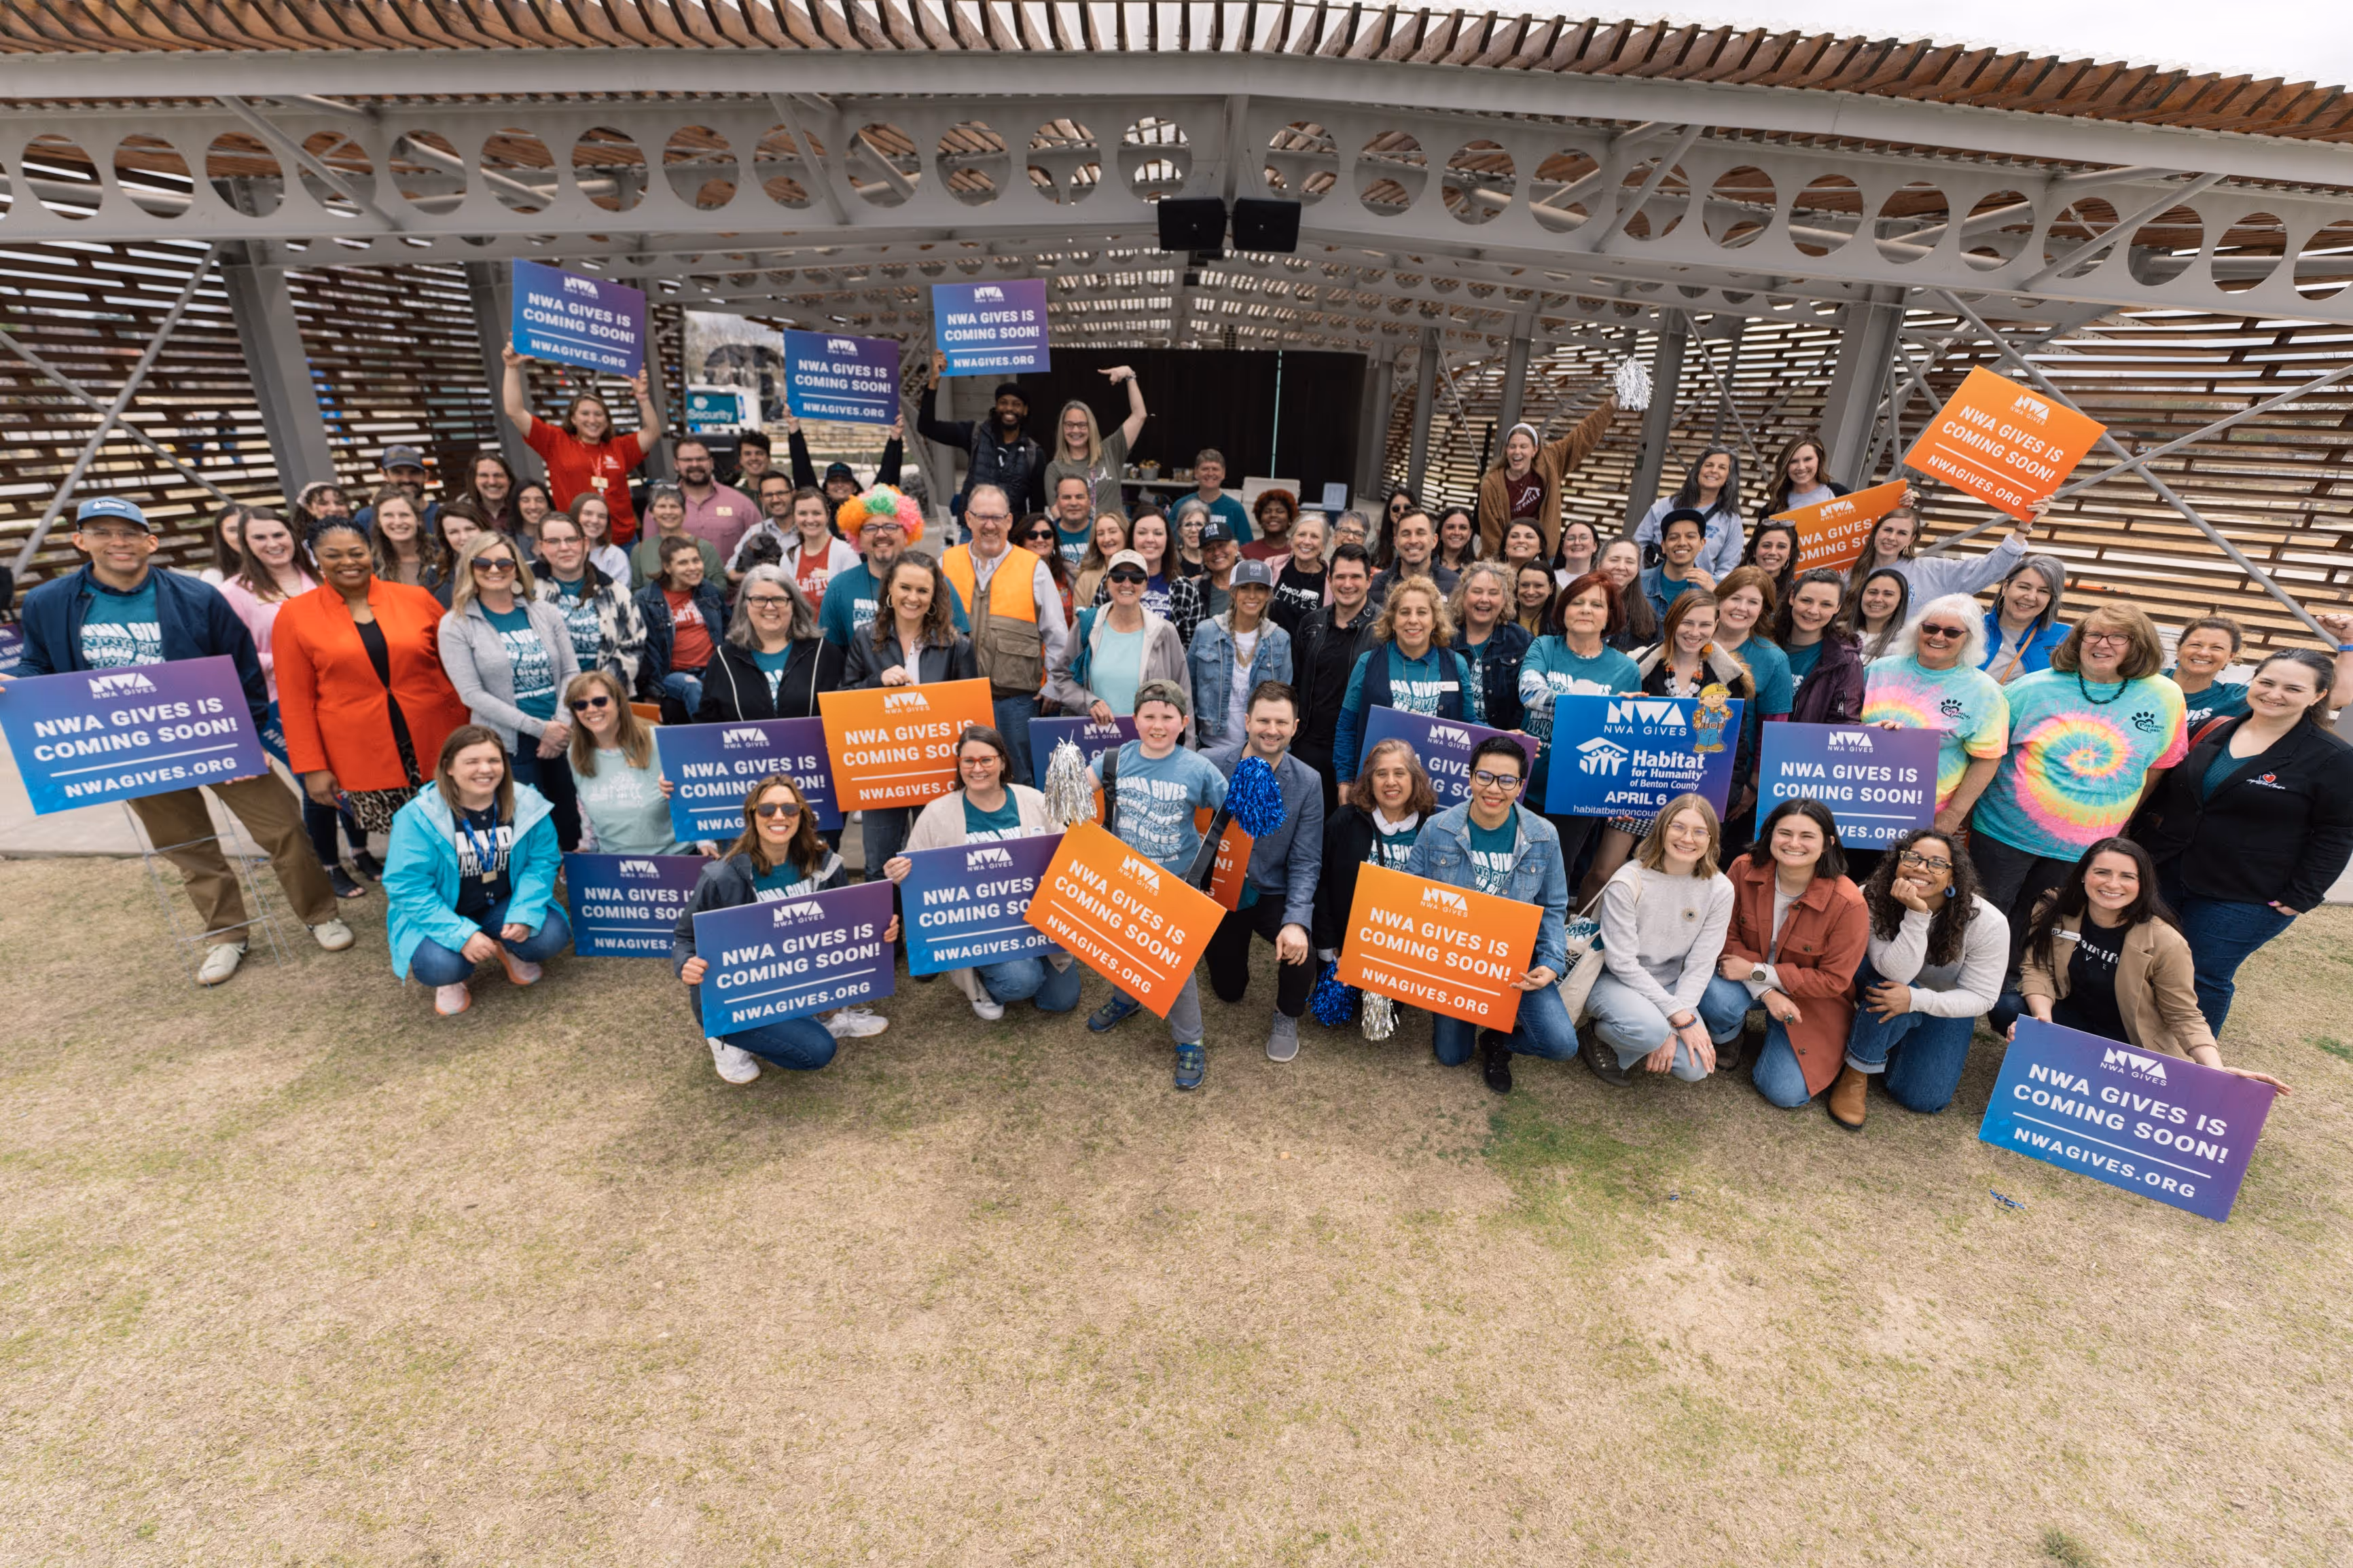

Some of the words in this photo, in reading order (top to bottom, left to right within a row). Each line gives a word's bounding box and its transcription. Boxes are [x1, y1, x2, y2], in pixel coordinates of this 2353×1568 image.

[528, 293, 564, 311] NWA
[569, 303, 612, 323] GIVES
[617, 314, 630, 327] IS
[947, 313, 976, 325] NWA
[980, 311, 1018, 323] GIVES
[1022, 310, 1035, 321] IS
[524, 308, 586, 332] COMING
[590, 325, 634, 344] SOON!
[945, 328, 996, 341] COMING
[1000, 326, 1039, 338] SOON!
[531, 340, 626, 367] NWAGIVES.ORG
[954, 355, 1034, 368] NWAGIVES.ORG
[798, 359, 829, 373] NWA
[833, 363, 870, 376] GIVES
[875, 367, 887, 378] IS
[795, 375, 848, 390] COMING
[852, 380, 891, 393] SOON!
[803, 403, 884, 418] NWAGIVES.ORG
[2014, 395, 2049, 420] NWA
[2026, 413, 2045, 426] GIVES
[1959, 405, 1996, 431] NWA
[1998, 424, 2045, 453] GIVES
[2045, 447, 2064, 462] IS
[1943, 421, 2005, 458] COMING
[2006, 452, 2055, 482] SOON!
[1928, 455, 2022, 506] NWAGIVES.ORG
[1820, 500, 1854, 516] NWA
[1800, 532, 1822, 546] WA
[1828, 518, 1872, 539] GIVES
[1798, 542, 1846, 562] OMING
[88, 672, 154, 693] NWA
[93, 690, 118, 699] NWA
[124, 686, 157, 696] GIVES
[884, 692, 928, 708] NWA
[33, 714, 104, 737] NWA
[111, 702, 191, 727] GIVES
[197, 697, 223, 714] IS
[1606, 700, 1686, 726] NWA
[722, 728, 768, 744] NWA
[845, 728, 890, 745] NWA
[895, 723, 950, 741] GIVES
[1084, 723, 1121, 735] NWA
[1430, 724, 1471, 745] NWA
[1604, 725, 1633, 734] NWA
[1643, 726, 1687, 736] GIVES
[1829, 731, 1873, 747] NWA
[34, 730, 150, 762] COMING
[158, 718, 238, 742] SOON!
[1448, 742, 1471, 751] GIVES
[683, 763, 728, 778] NWA
[734, 758, 791, 774] GIVES
[798, 756, 816, 770] IS
[843, 747, 920, 767] COMING
[1429, 757, 1470, 777] GIVE
[1632, 750, 1706, 769] Habitat
[65, 757, 237, 798] NWAGIVES.ORG
[1632, 768, 1648, 778] for
[1781, 761, 1825, 778] NWA
[1833, 765, 1891, 781] GIVES
[1899, 769, 1918, 782] IS
[859, 781, 956, 801] NWAGIVES.O
[1151, 780, 1187, 801] GIVES
[1640, 780, 1668, 789] Benton
[1670, 781, 1699, 790] County
[1773, 782, 1853, 801] COMING
[1860, 788, 1922, 804] SOON!
[1604, 791, 1655, 805] APRIL
[1656, 794, 1667, 805] 6
[1573, 805, 1659, 816] habitatbentoncoun
[619, 860, 658, 873] NWA
[967, 847, 1011, 867] NWA
[990, 860, 1013, 869] GIVES
[1490, 852, 1513, 872] GIV
[1117, 867, 1134, 880] NWA
[1136, 879, 1159, 896] GIVES
[1122, 854, 1160, 891] NWA
[584, 888, 624, 901] NWA
[628, 888, 679, 902] GIVES
[922, 887, 971, 906] NWA
[975, 877, 1034, 898] GIVES
[1068, 859, 1107, 895] NWA
[1112, 889, 1164, 931] GIVES
[1166, 924, 1186, 945] IS
[1422, 886, 1468, 911] NWA
[582, 905, 650, 919] COMING
[773, 900, 823, 922] NWA
[918, 902, 1001, 928] COMING
[1420, 900, 1439, 910] NWA
[1443, 907, 1468, 917] GIVES
[773, 920, 794, 928] NWA
[798, 913, 825, 924] GIVES
[1055, 876, 1121, 930] COMING
[1125, 923, 1182, 968] SOON!
[1369, 907, 1414, 933] NWA
[1421, 923, 1481, 950] GIVES
[1488, 940, 1509, 957] IS
[594, 938, 675, 950] NWAGIVES.
[721, 944, 776, 966] NWA
[783, 929, 846, 953] GIVES
[854, 924, 874, 940] IS
[1047, 915, 1152, 994] NWAGIVES.ORG
[1360, 928, 1439, 962] COMING
[1445, 951, 1511, 981] SOON!
[717, 958, 808, 989] COMING
[816, 943, 880, 968] SOON!
[1362, 968, 1489, 1015] NWAGIVES.ORG
[732, 982, 870, 1023] NWAGIVES.ORG
[2100, 1061, 2125, 1074] NWA
[2132, 1071, 2168, 1086] GIVES
[2104, 1047, 2168, 1080] NWA
[2028, 1063, 2089, 1096] NWA
[2101, 1087, 2188, 1124] GIVES
[2196, 1114, 2227, 1136] IS
[2013, 1084, 2125, 1130] COMING
[2134, 1123, 2229, 1163] SOON!
[2014, 1127, 2196, 1198] NWAGIVES.ORG
